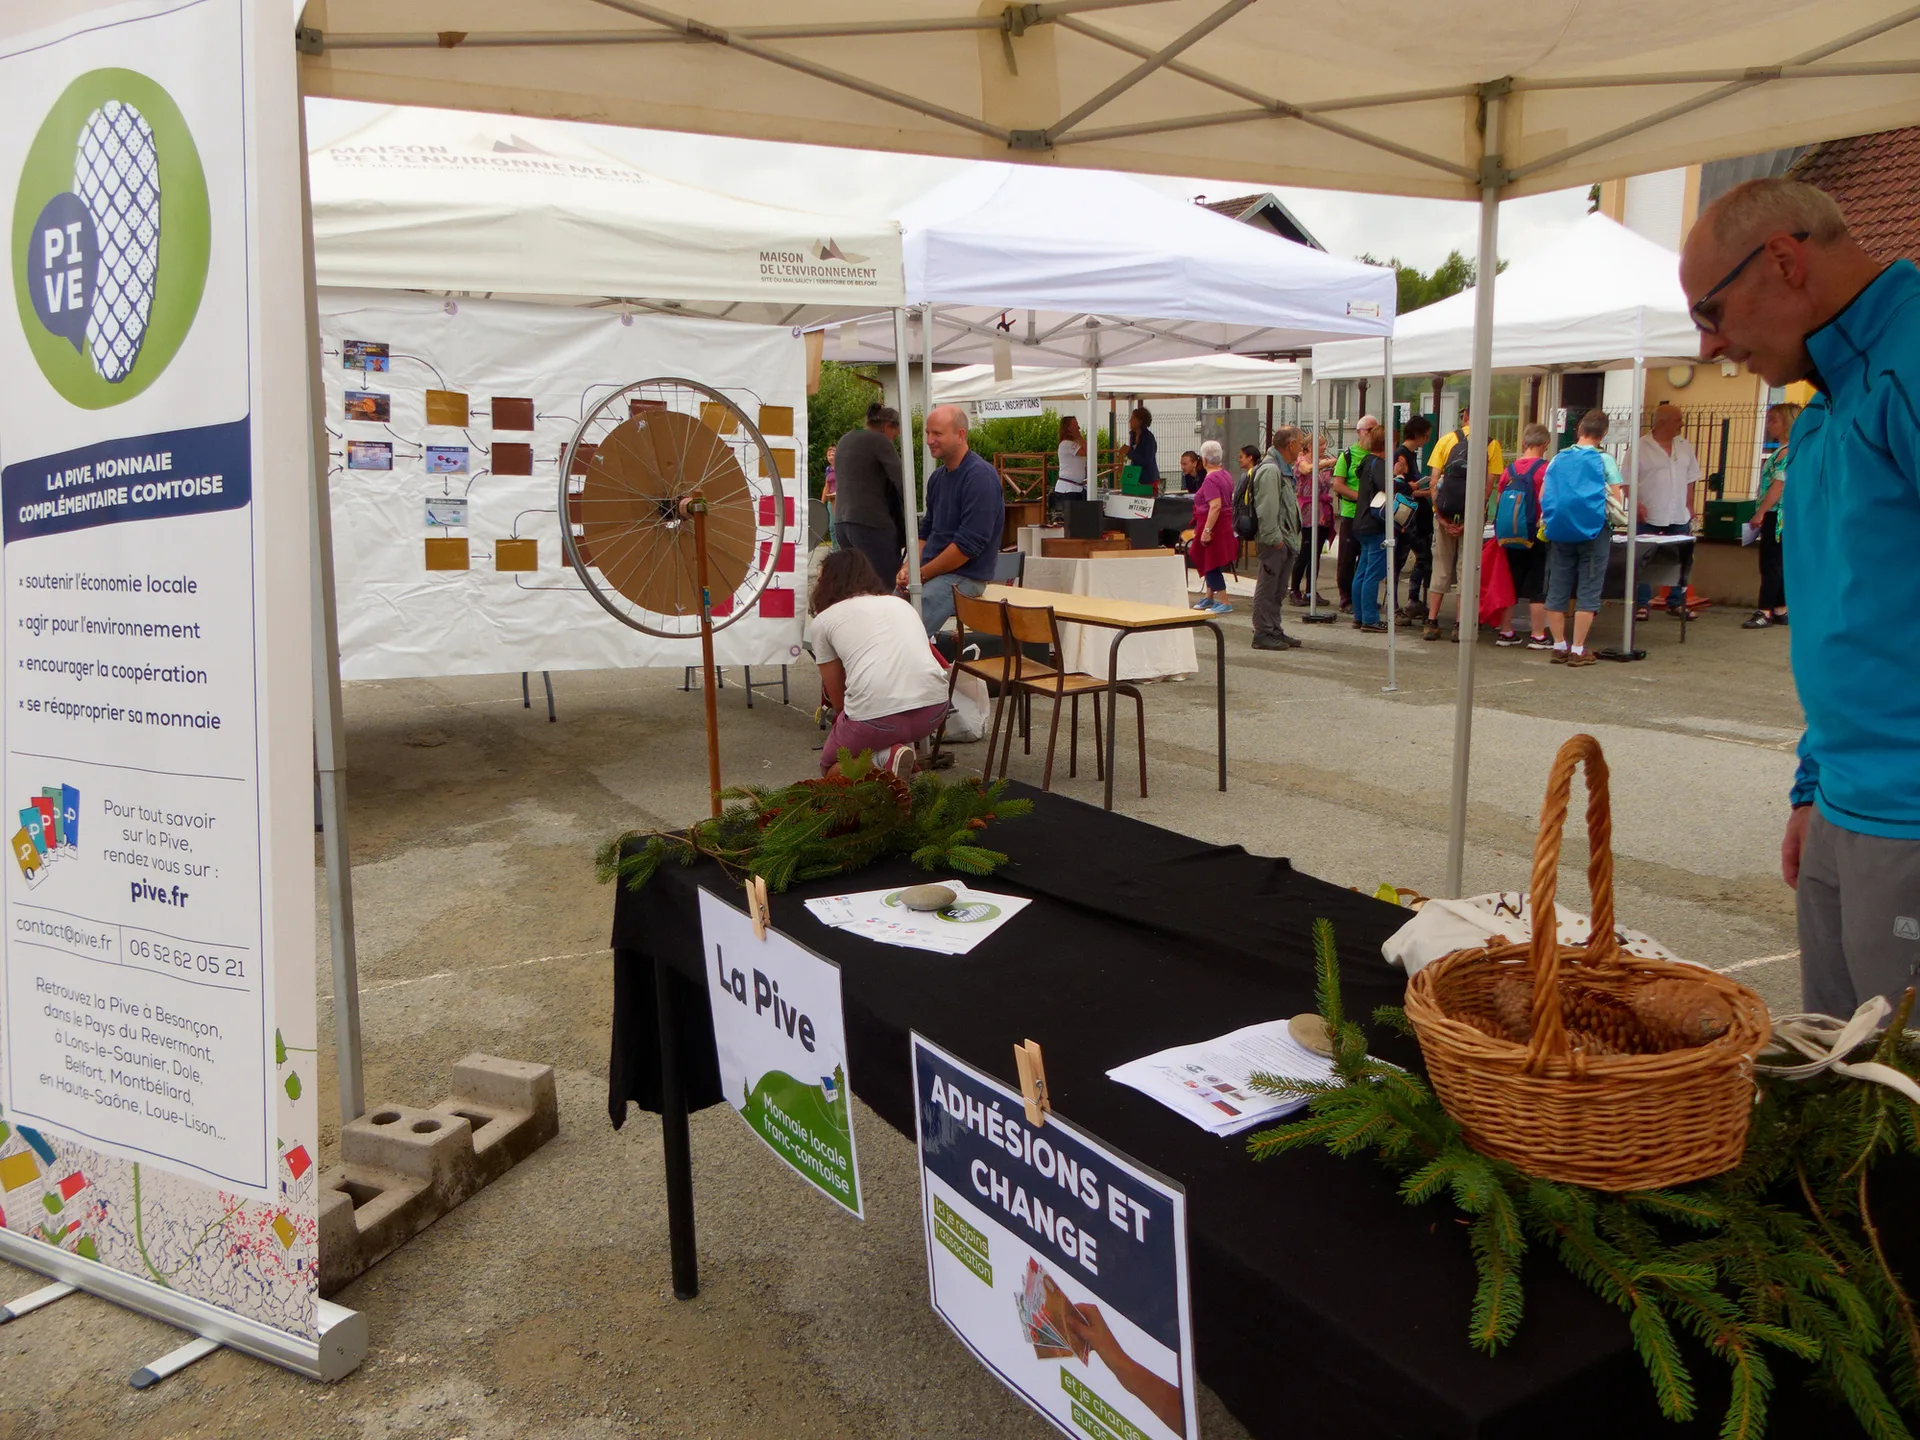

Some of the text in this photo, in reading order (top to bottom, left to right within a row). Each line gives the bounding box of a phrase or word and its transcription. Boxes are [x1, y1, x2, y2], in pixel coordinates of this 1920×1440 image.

[760, 252, 803, 263] MAISON
[760, 264, 774, 274] DE
[46, 474, 64, 491] LA
[96, 452, 173, 480] MONNAIE
[19, 475, 223, 523] COMPLÉMENTAIRE COMTOISE
[25, 573, 74, 590] soutenir
[75, 573, 142, 592] l'économie
[147, 575, 197, 594] locale
[26, 614, 49, 636] agir
[52, 618, 79, 635] pour
[81, 615, 201, 639] l'environnement
[27, 658, 94, 681] encourager
[97, 659, 109, 677] la
[112, 663, 207, 684] coopération
[27, 698, 41, 712] se
[44, 697, 125, 723] réapproprier
[129, 709, 143, 723] sa
[146, 711, 221, 729] monnaie
[104, 799, 216, 829] Pour tout savoir
[103, 849, 149, 867] rendez
[151, 857, 180, 874] vous
[122, 829, 193, 853] sur la Pive,
[131, 878, 189, 908] pive.fr
[16, 917, 245, 977] contact@pive.fr 06 52 62 05 21
[36, 977, 223, 1040] Retrouvez la Pive à Besançon,
[716, 943, 816, 1053] La Pive
[44, 1004, 214, 1064] dans le Pays du Revermont,
[55, 1028, 62, 1043] à
[173, 1060, 203, 1085] Dole,
[40, 1073, 53, 1087] en
[57, 1077, 142, 1115] Haute-Saône,
[65, 1055, 194, 1106] Belfort, Montbéliard,
[763, 1092, 847, 1172] Monnaie locale
[763, 1114, 850, 1195] franc-comtoise
[931, 1074, 1150, 1243] ADHÉSIONS ET
[935, 1198, 988, 1253] Ici je rejoins
[971, 1159, 1098, 1276] CHANGE
[1064, 1375, 1140, 1440] et je change
[1073, 1407, 1108, 1440] euros
